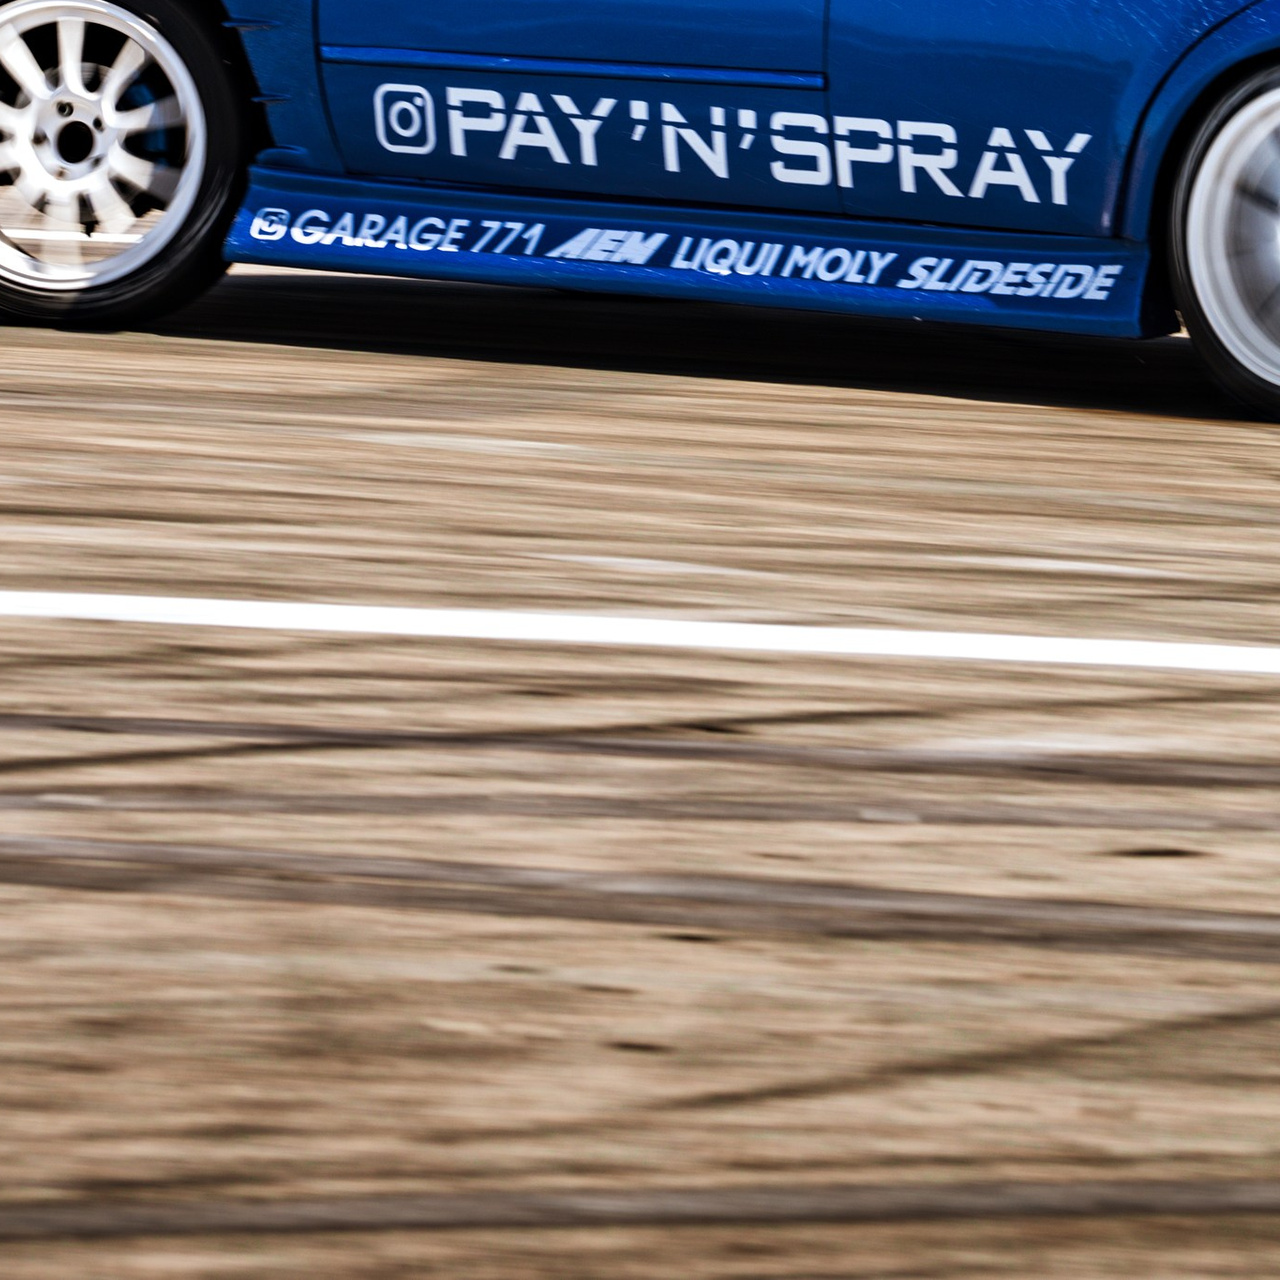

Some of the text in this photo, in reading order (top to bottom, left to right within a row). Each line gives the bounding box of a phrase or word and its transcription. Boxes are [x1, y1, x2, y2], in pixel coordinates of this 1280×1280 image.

[446, 86, 1093, 206] PAY'N'SPRAY
[290, 209, 471, 252] GARAGE
[471, 218, 546, 256] 771
[670, 236, 784, 276] LIQUI
[781, 244, 898, 284] MOLY
[896, 257, 1123, 301] SLIDESIDE
